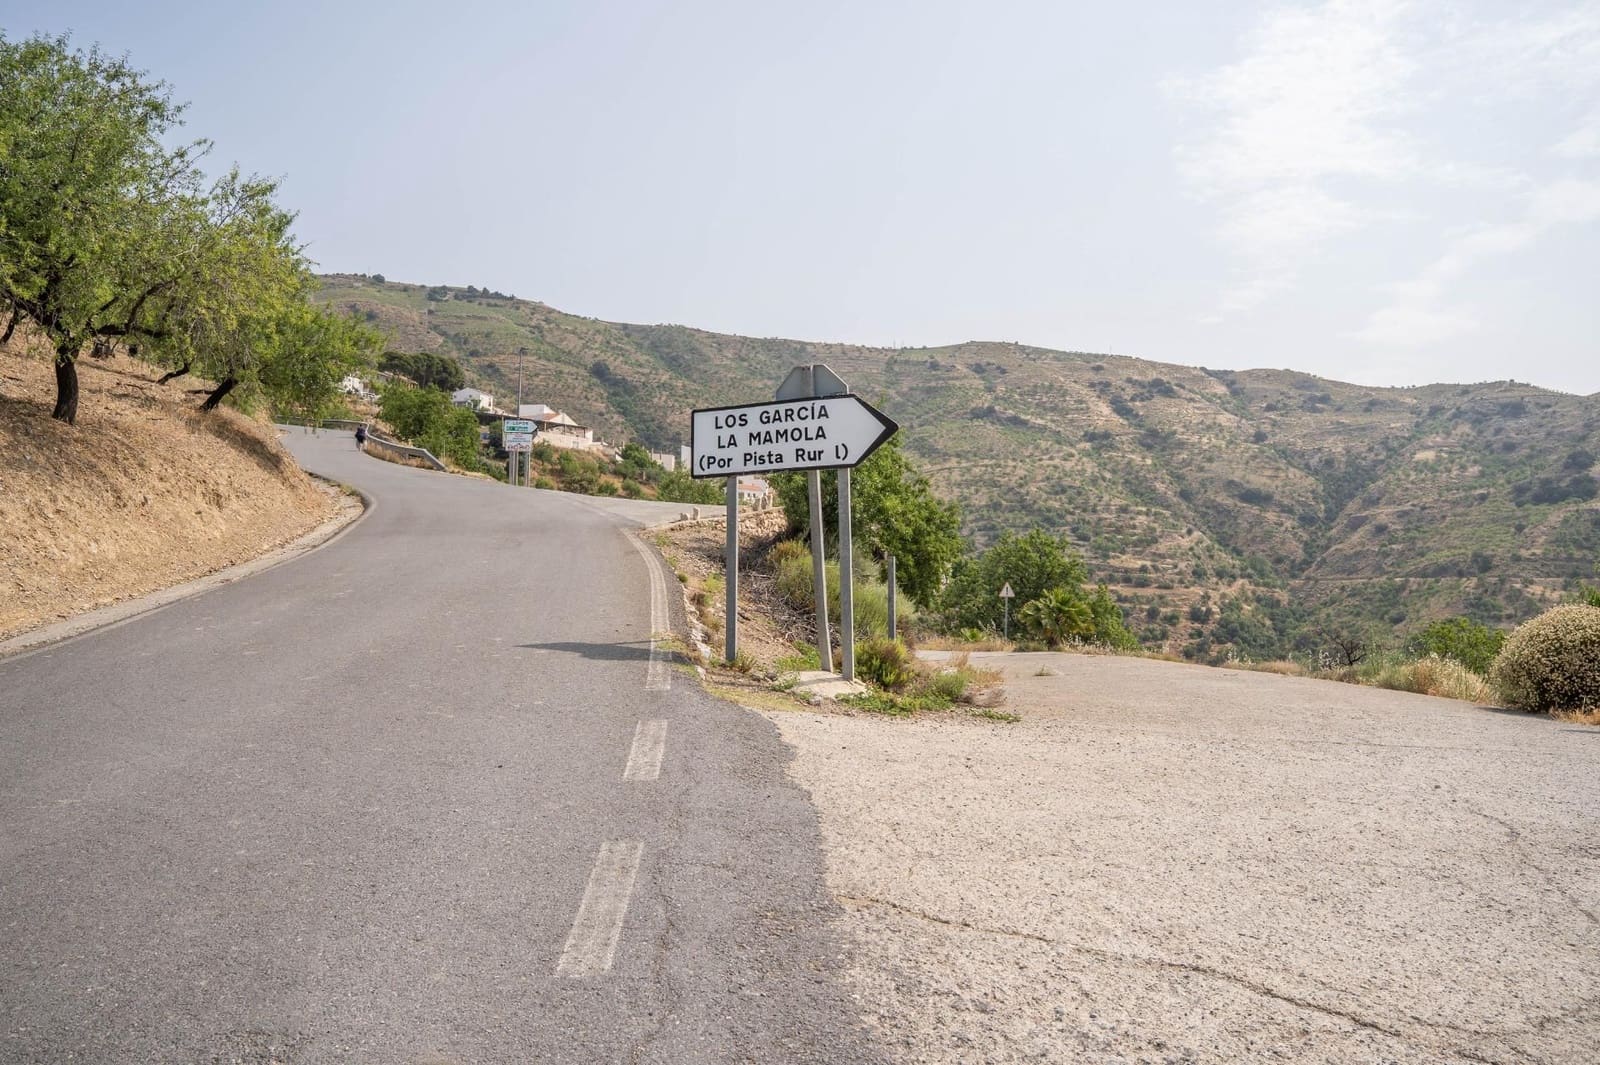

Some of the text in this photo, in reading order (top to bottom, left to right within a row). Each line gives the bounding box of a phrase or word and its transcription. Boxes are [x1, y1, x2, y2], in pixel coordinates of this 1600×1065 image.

[715, 402, 830, 430] LOS GARCÍA
[717, 425, 827, 449] LA MAMOLA
[699, 454, 733, 471] (Por
[743, 450, 784, 467] Pista
